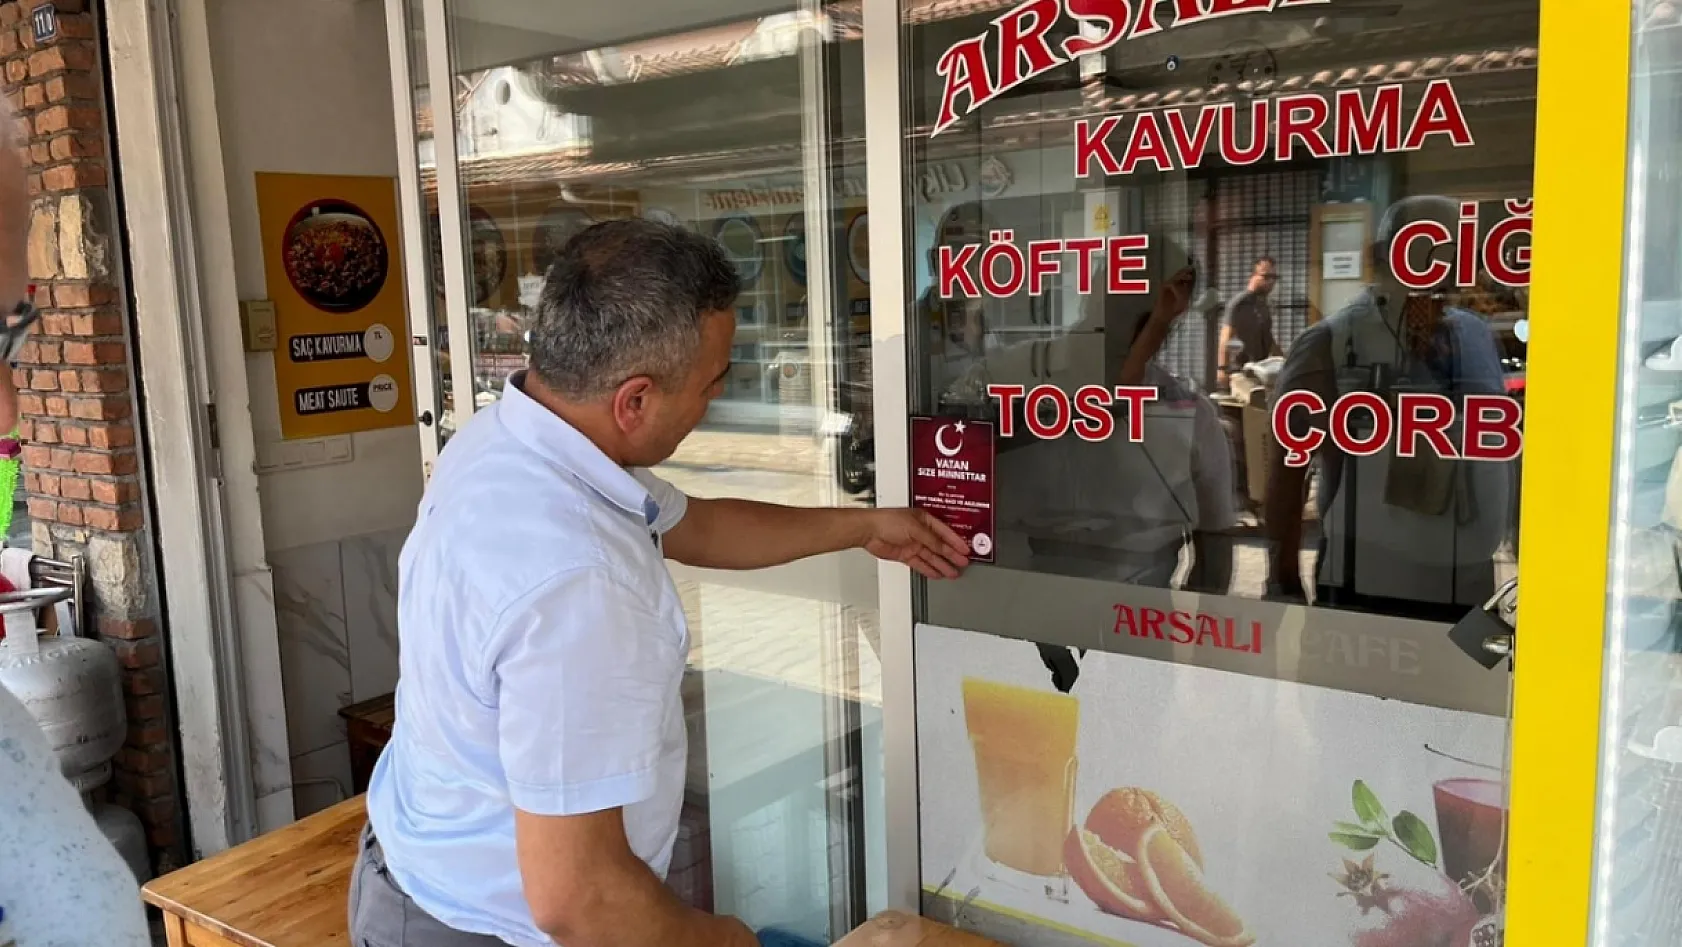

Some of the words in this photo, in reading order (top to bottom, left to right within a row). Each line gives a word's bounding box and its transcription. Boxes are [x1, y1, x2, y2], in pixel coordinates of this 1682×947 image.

[1075, 79, 1474, 177] KAVURMA
[940, 230, 1148, 297] KÖFTE
[292, 337, 314, 361] SAÇ
[315, 334, 361, 355] KAVURMA
[299, 391, 325, 411] MEAT
[328, 388, 359, 408] SAUTE
[988, 385, 1157, 441] TOST
[1272, 389, 1523, 465] ÇORB
[935, 457, 969, 471] VATAN
[1113, 603, 1262, 655] ARSALI
